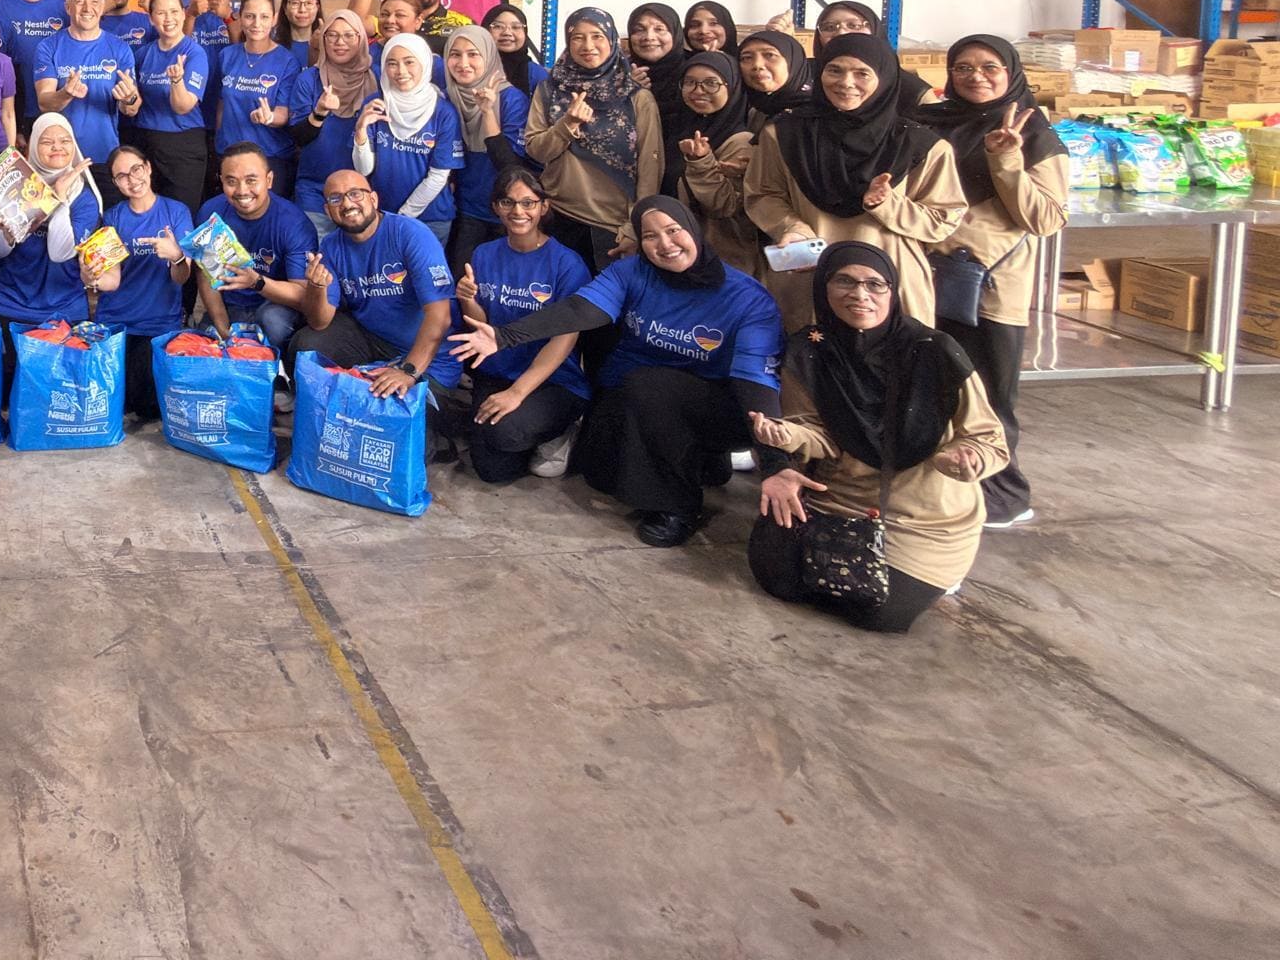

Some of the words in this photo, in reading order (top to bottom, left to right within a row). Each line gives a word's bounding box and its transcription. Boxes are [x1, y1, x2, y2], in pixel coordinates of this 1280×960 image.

[24, 20, 49, 29] Nestlé
[235, 83, 267, 94] Komuniti
[359, 273, 386, 287] Netlé
[362, 285, 404, 298] Kmuniti
[501, 284, 529, 297] Nestlé
[500, 294, 543, 311] Komuniti
[649, 320, 693, 342] Nestlé
[646, 333, 709, 361] Komuniti
[364, 444, 391, 456] FOOD
[363, 451, 390, 464] BANK
[329, 464, 352, 478] SUSUR
